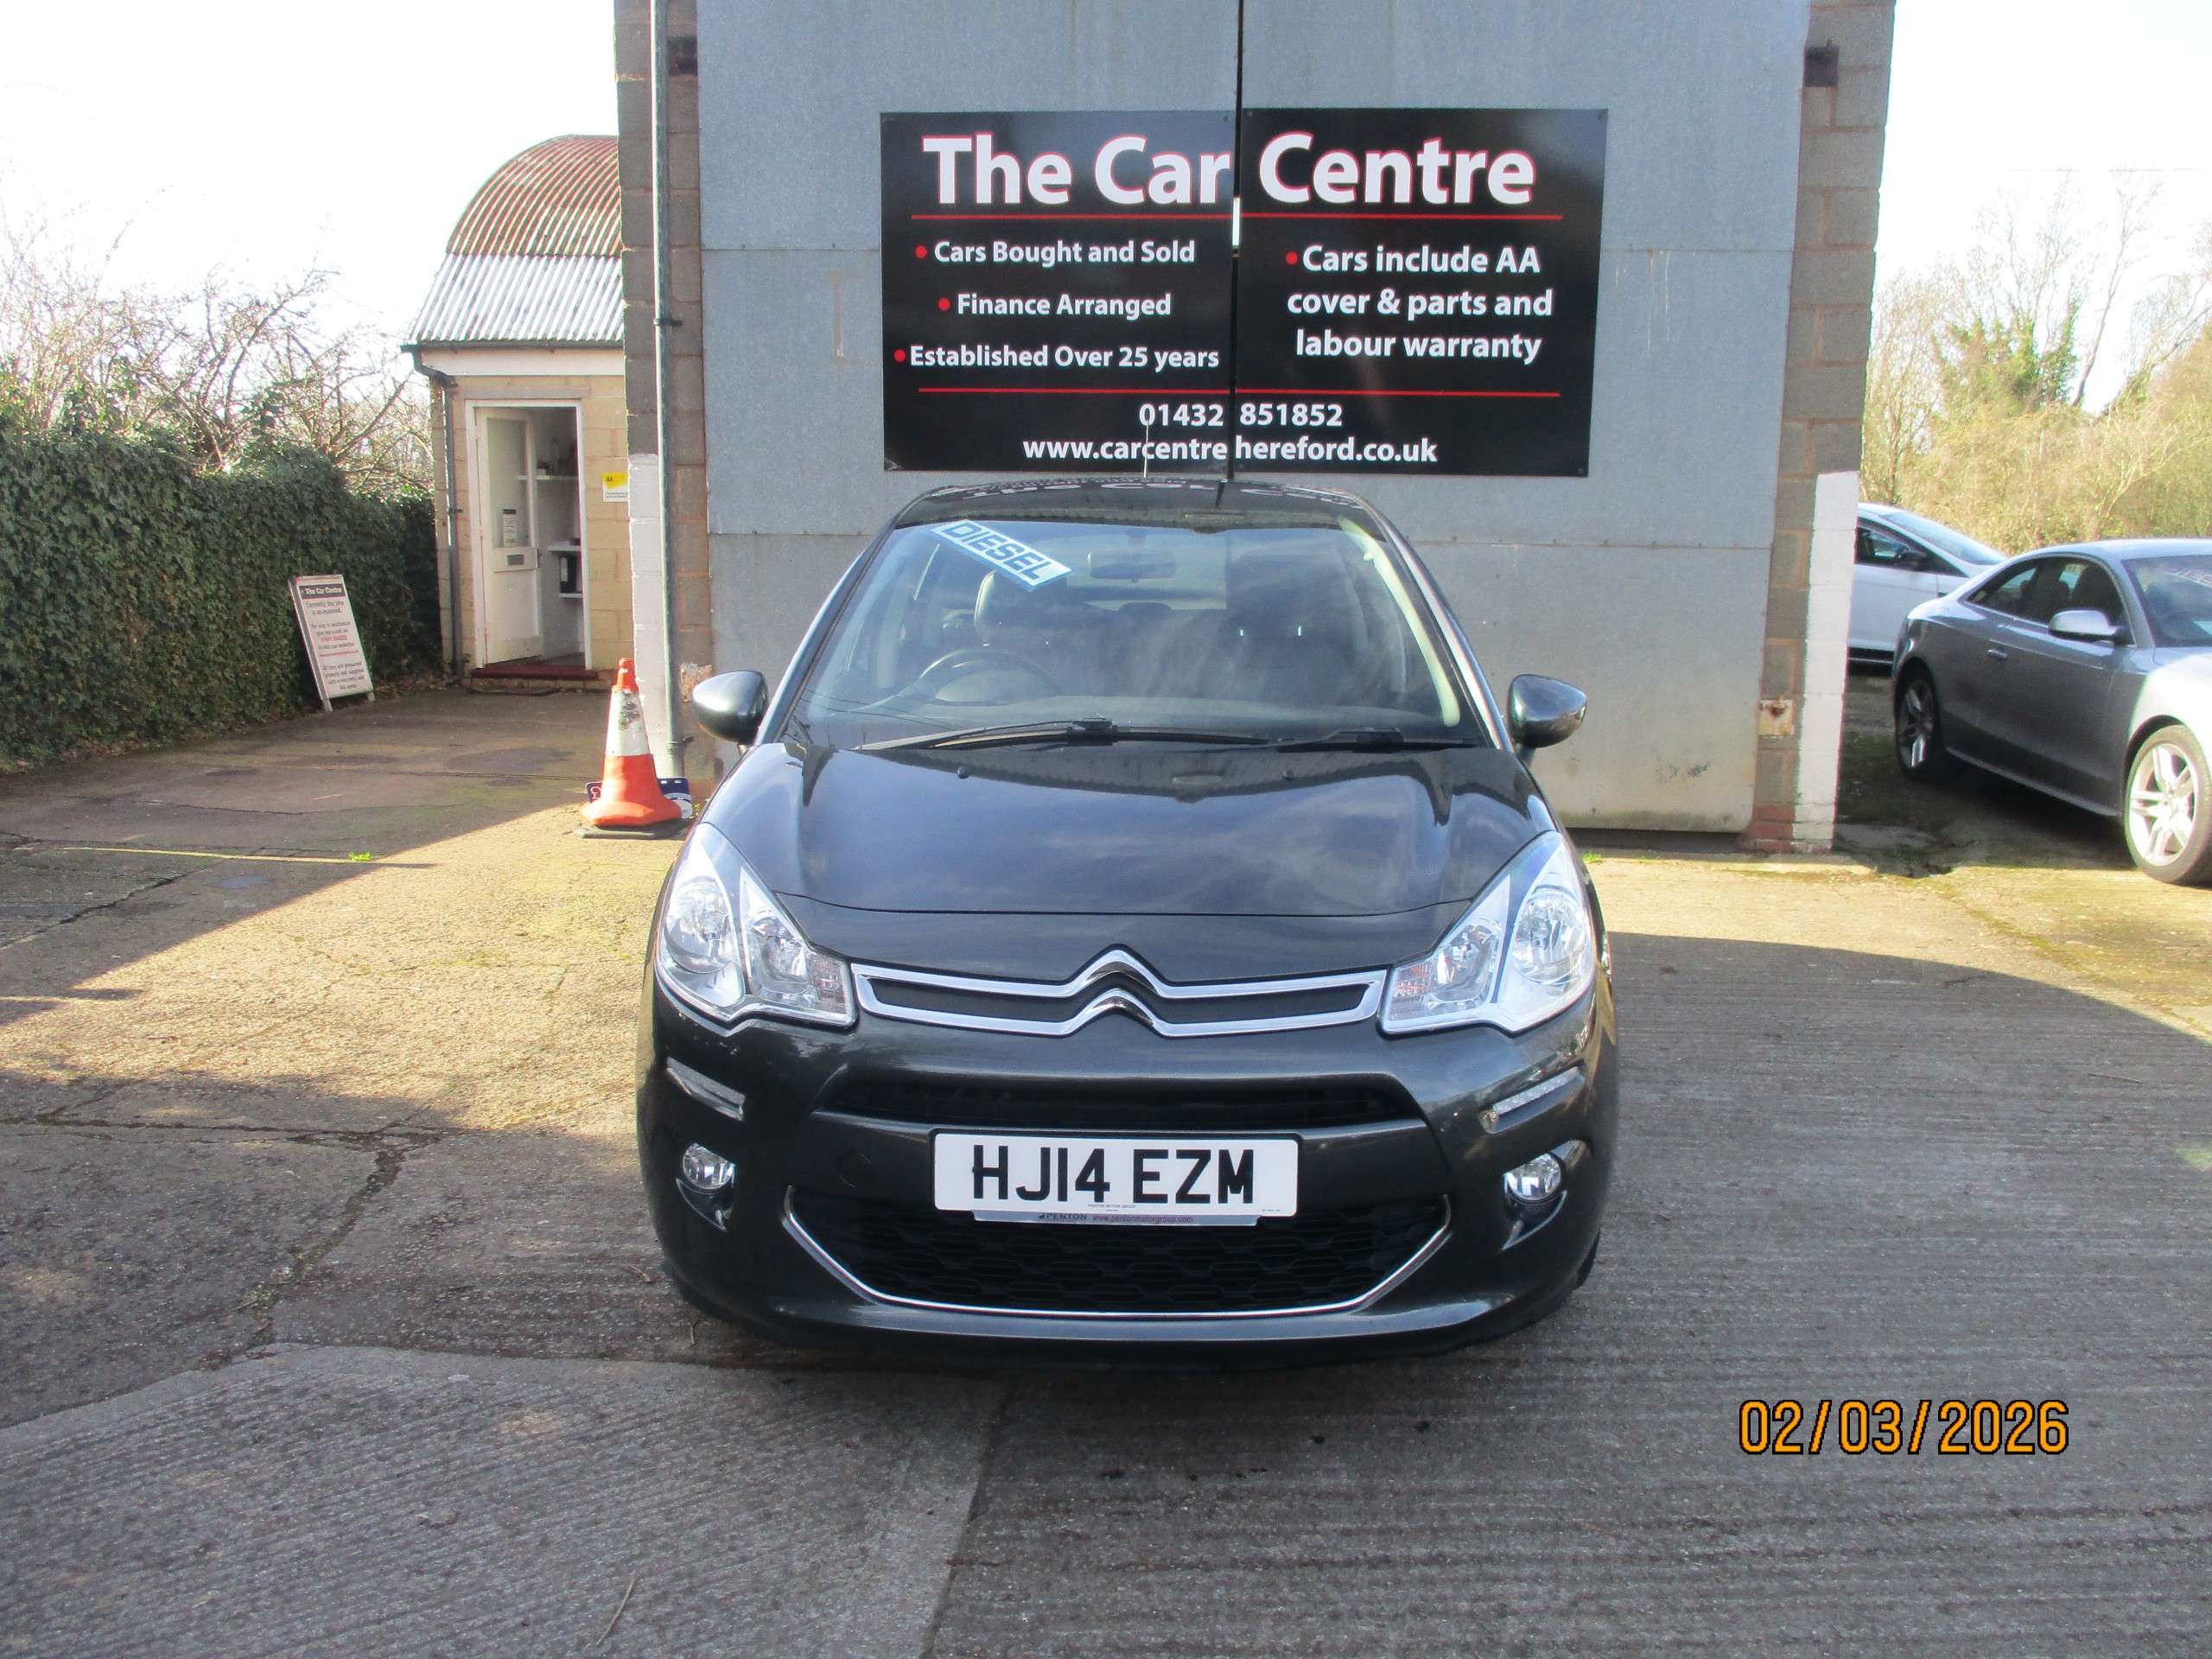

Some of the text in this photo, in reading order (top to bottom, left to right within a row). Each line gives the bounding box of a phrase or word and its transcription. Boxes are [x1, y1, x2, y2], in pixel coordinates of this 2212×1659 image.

[923, 132, 1534, 205] The Car Centre
[935, 240, 1194, 267] Cars Bought and Sold
[1303, 245, 1540, 272] Cars include AA
[958, 293, 1171, 320] Finance Arranged
[1288, 289, 1552, 321] cover & parts and
[911, 345, 1218, 372] Established Over 25 years
[1297, 329, 1541, 365] labour warranty
[1140, 404, 1342, 428] 01432 851852
[942, 522, 1052, 580] DIESEL
[973, 1144, 1255, 1205] HJ14 EZM
[1092, 1215, 1194, 1224] www.pentonmotorgroup.com
